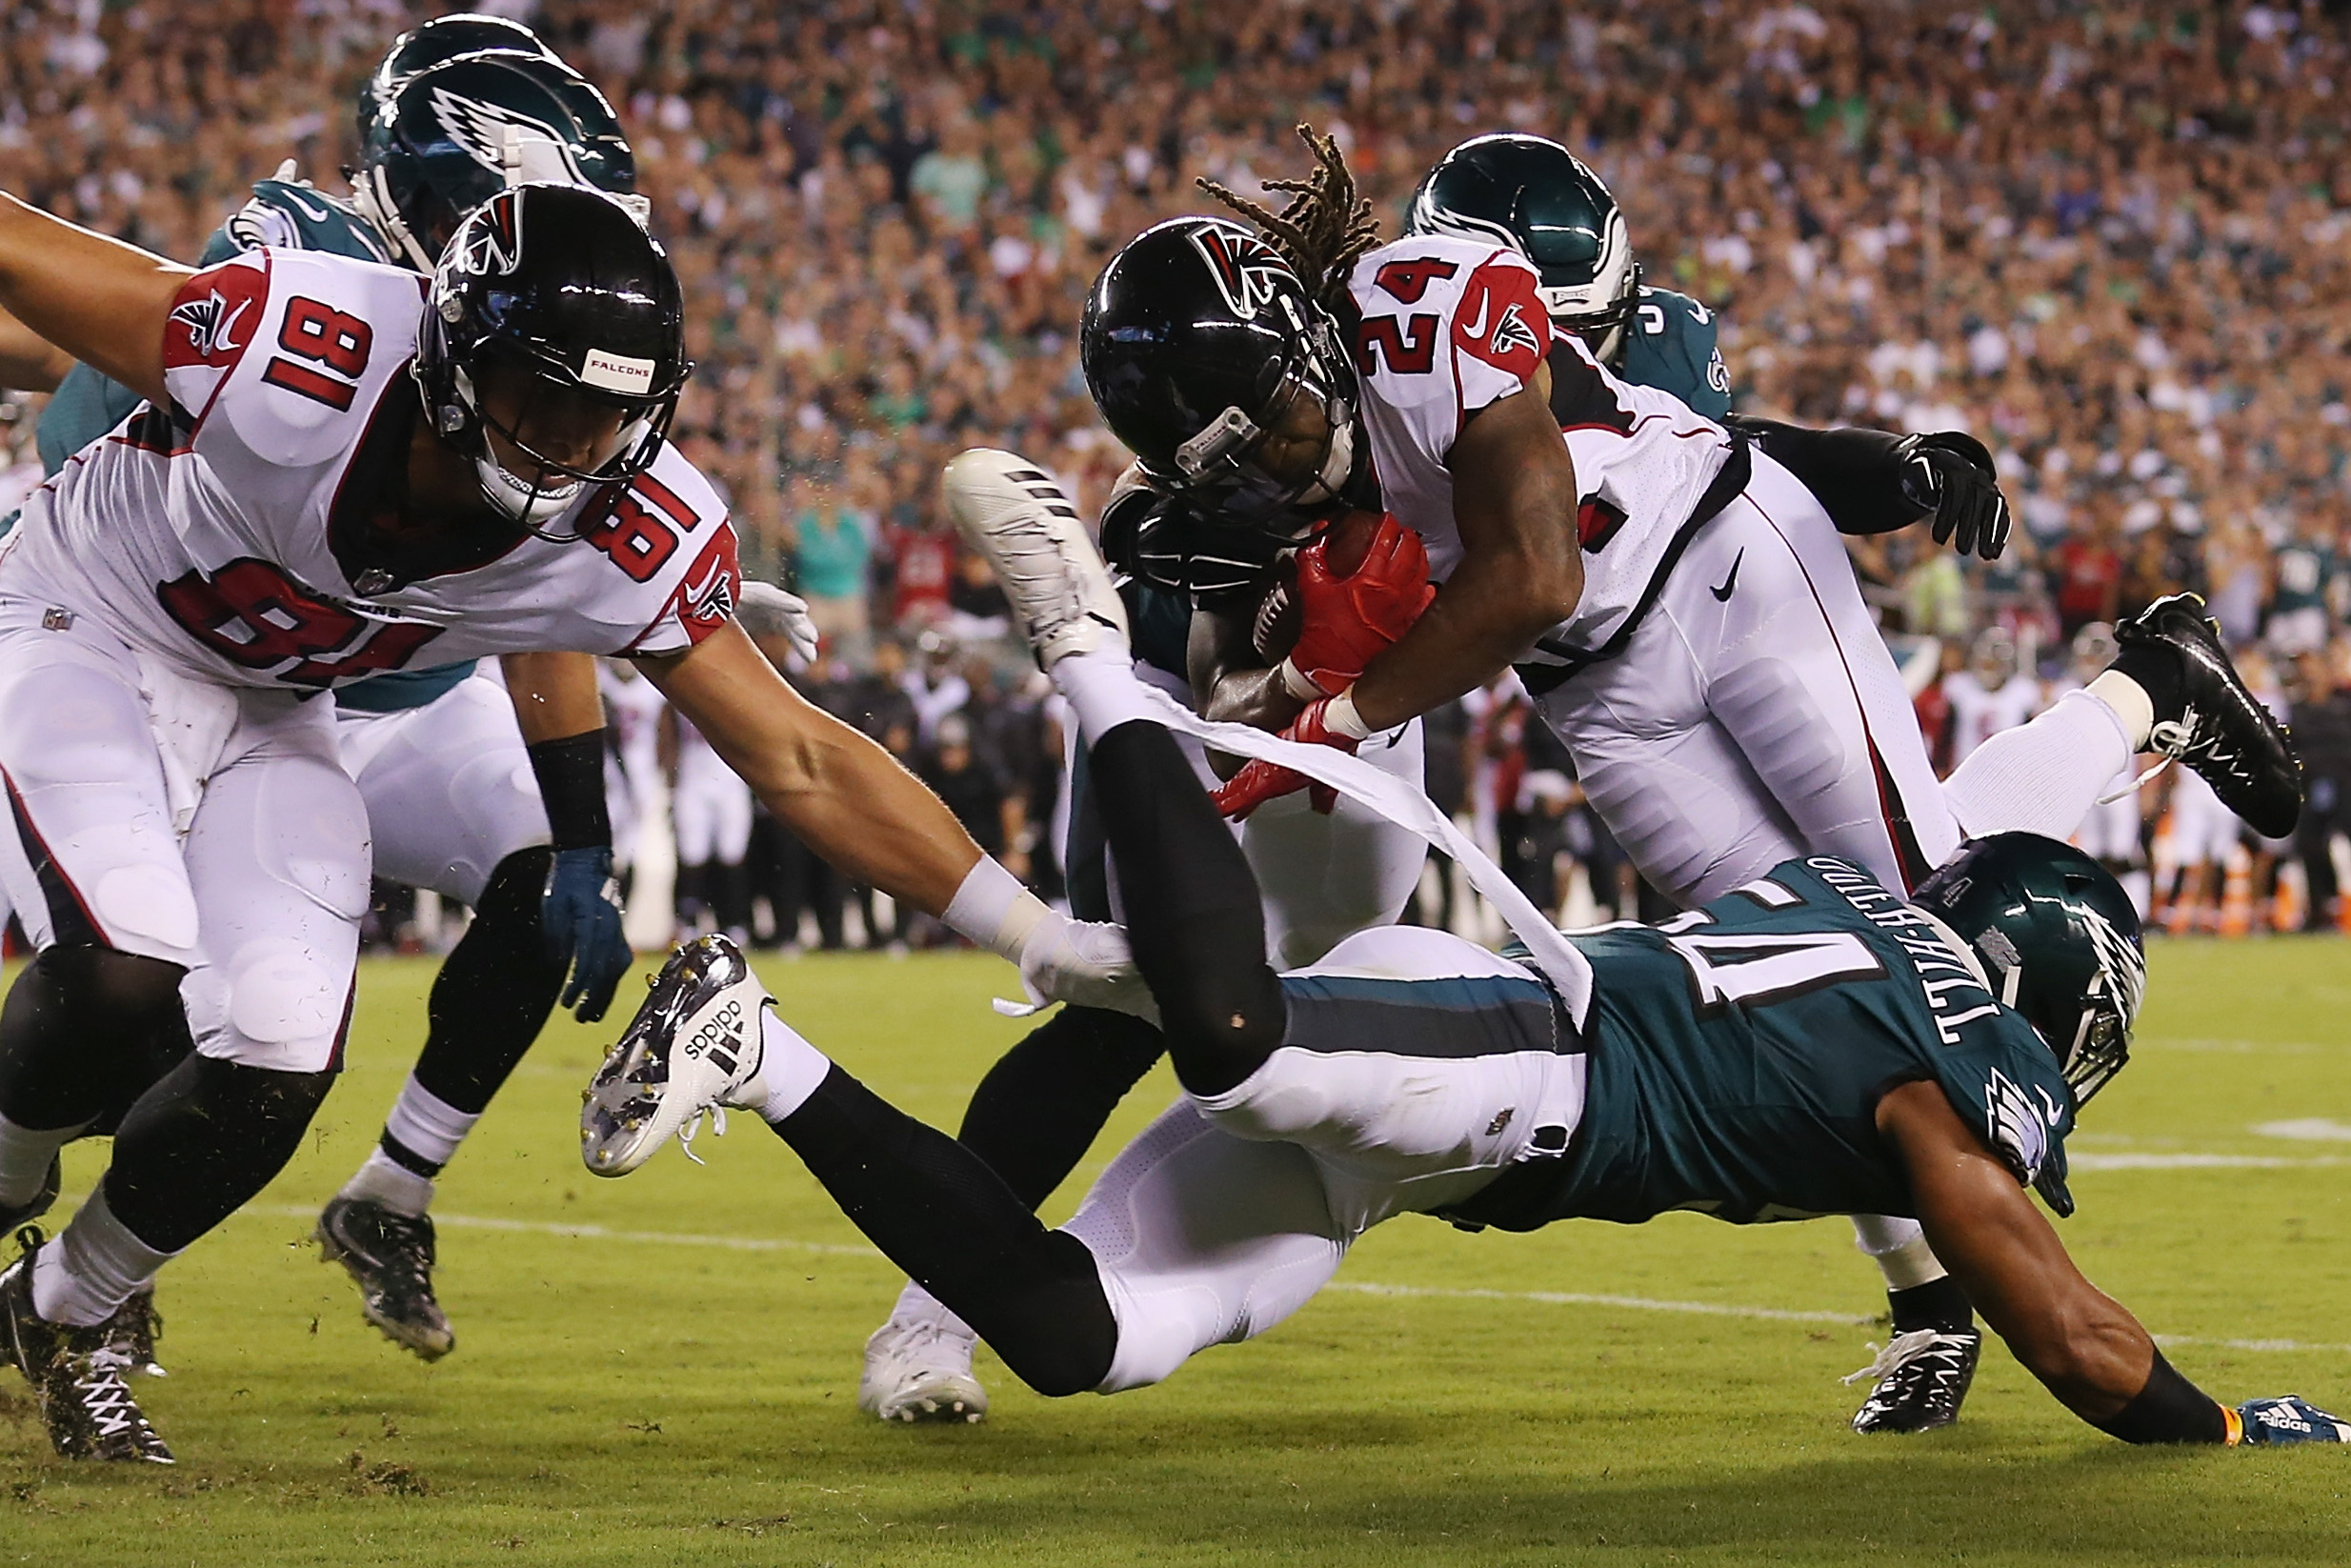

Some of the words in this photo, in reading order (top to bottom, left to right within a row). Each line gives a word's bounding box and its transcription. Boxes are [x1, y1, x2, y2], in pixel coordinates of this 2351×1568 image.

[260, 295, 373, 413] 81
[591, 360, 651, 377] FALCONS
[1356, 256, 1459, 376] 24
[573, 471, 701, 584] 81
[157, 556, 447, 688] 81
[684, 1000, 741, 1060] adidas
